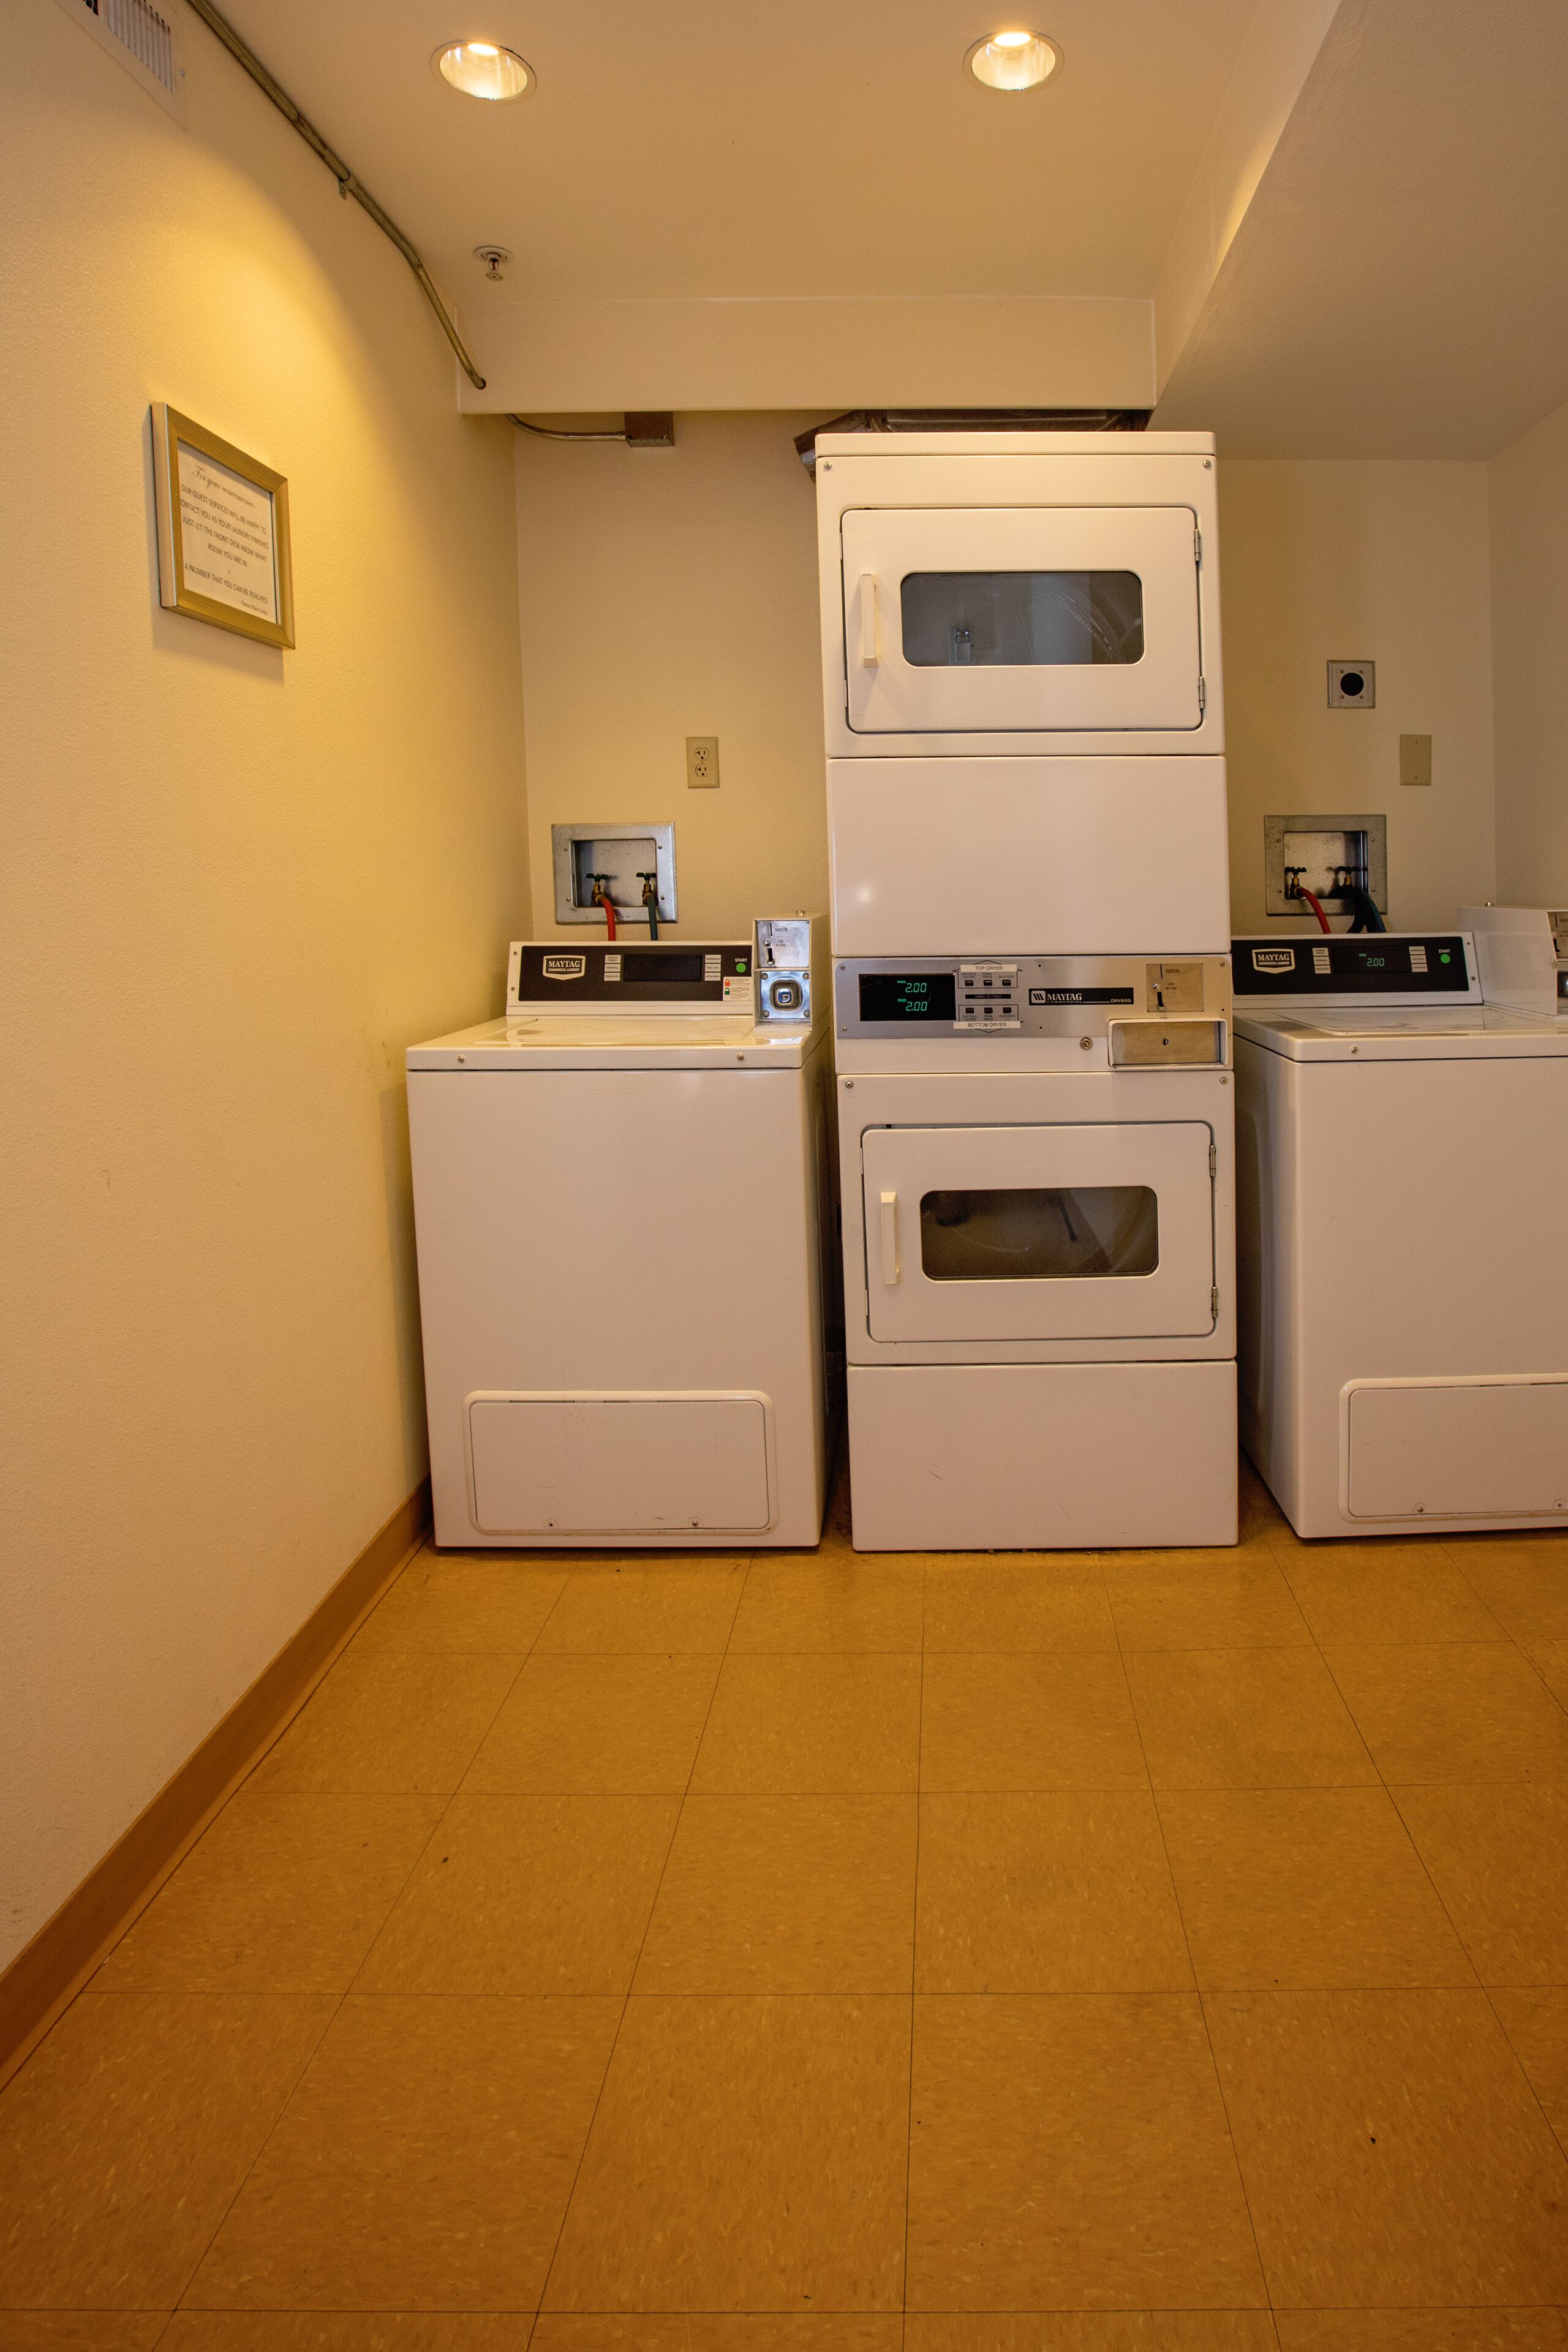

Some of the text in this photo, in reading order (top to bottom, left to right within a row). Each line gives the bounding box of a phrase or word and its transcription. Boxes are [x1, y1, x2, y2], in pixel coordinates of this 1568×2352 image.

[192, 466, 206, 481] For
[206, 479, 221, 489] your
[181, 484, 192, 495] OUR
[192, 491, 208, 503] GUEST
[209, 499, 229, 514] SERVICES
[230, 510, 239, 521] WILL
[247, 519, 260, 531] HAPPY
[260, 526, 266, 535] TO
[181, 499, 199, 514] ONTACT
[201, 509, 211, 519] YOU
[212, 515, 217, 524] AS
[217, 518, 230, 529] YOUR
[232, 526, 251, 539] LAUNDRY
[183, 516, 194, 526] JUST
[204, 526, 213, 536] THE
[214, 530, 228, 543] FRONT
[230, 538, 239, 549] DESK
[241, 543, 254, 556] KNOW
[255, 551, 267, 562] WHAT
[208, 543, 222, 556] ROOM
[223, 550, 233, 560] YOU
[243, 559, 247, 567] IN
[189, 564, 211, 579] NUMBER
[211, 573, 222, 584] THAT
[224, 579, 233, 589] YOU
[233, 584, 243, 593] CAN
[243, 587, 249, 596] BE
[1367, 958, 1385, 967] 2.00
[905, 983, 927, 992] 2.00
[906, 1001, 927, 1011] 2.00
